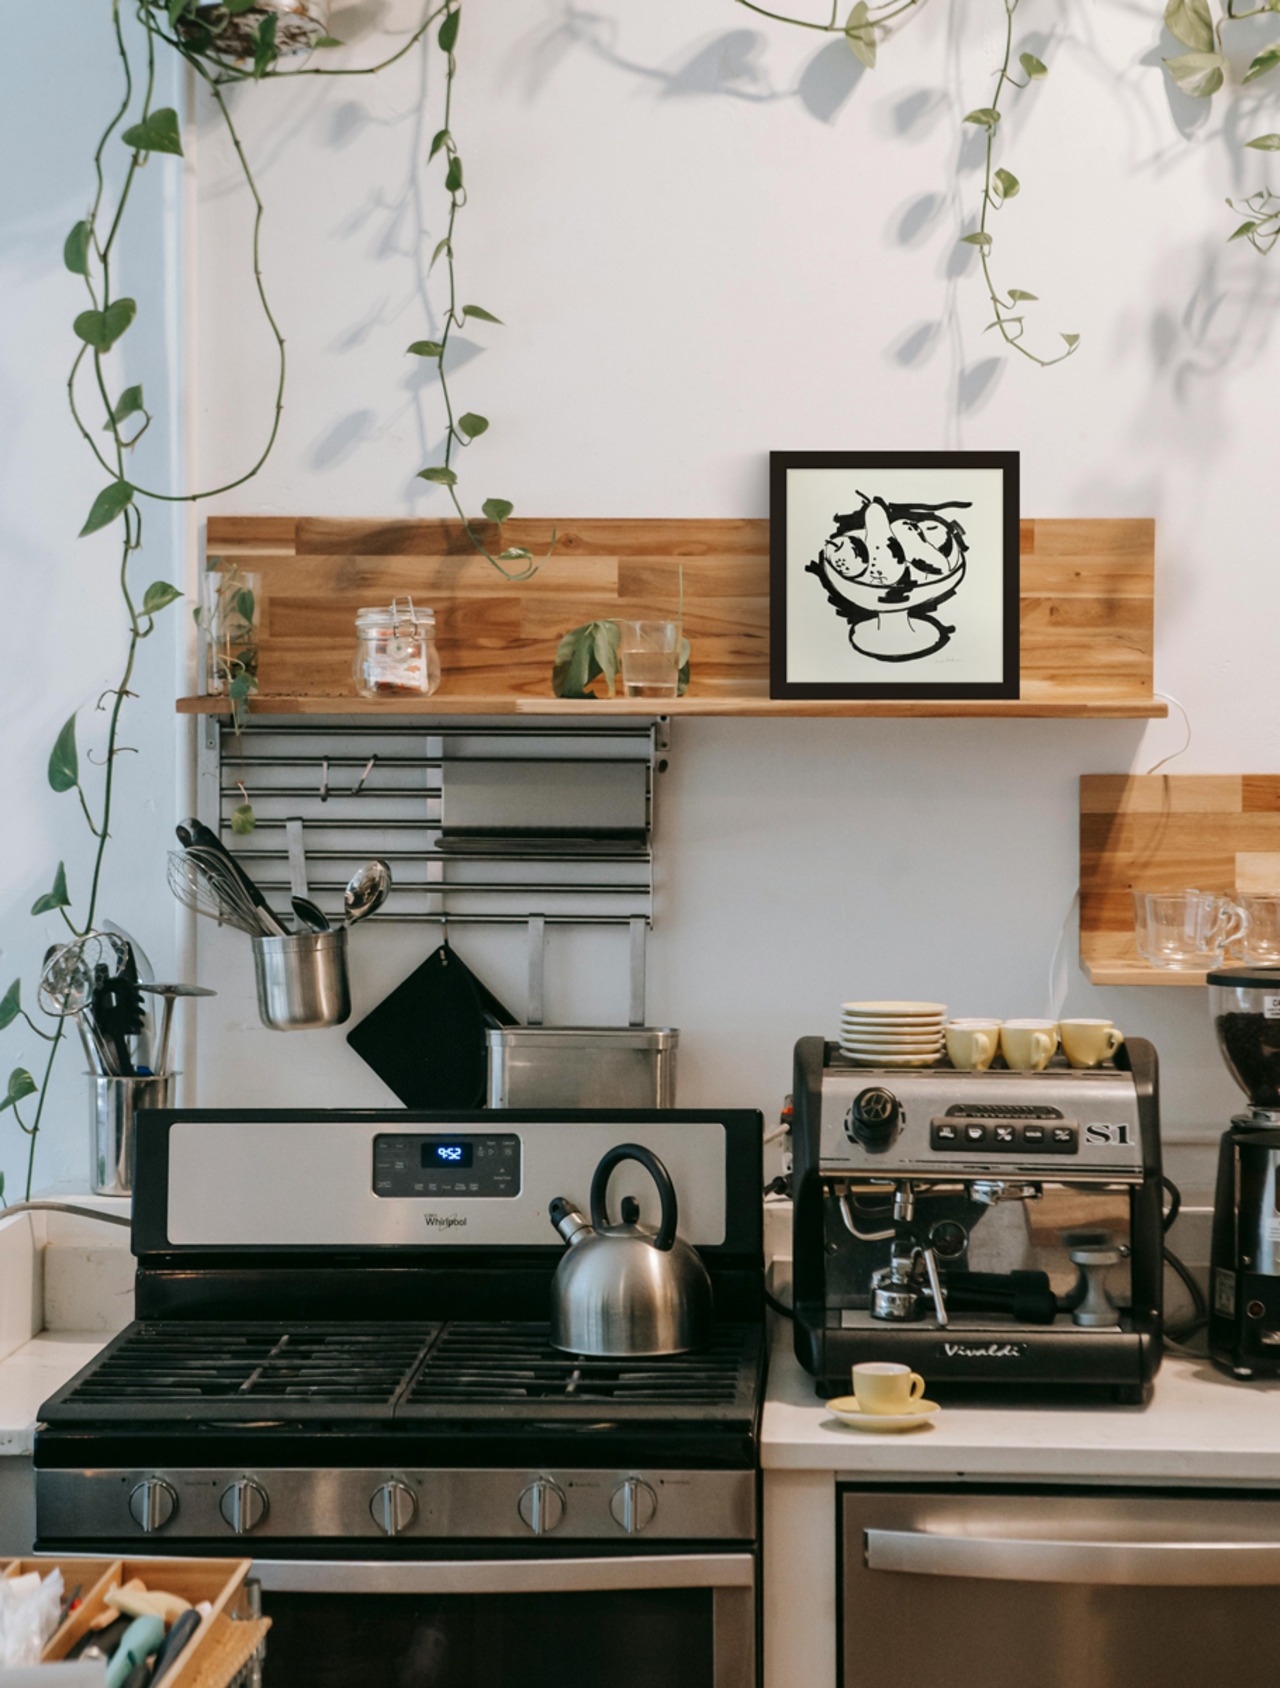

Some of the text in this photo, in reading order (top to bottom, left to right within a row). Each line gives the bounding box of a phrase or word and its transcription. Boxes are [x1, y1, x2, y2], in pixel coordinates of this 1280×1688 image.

[1085, 1123, 1134, 1145] S1
[425, 1217, 468, 1228] Whirlpool
[944, 1343, 1020, 1357] Vivaldi
